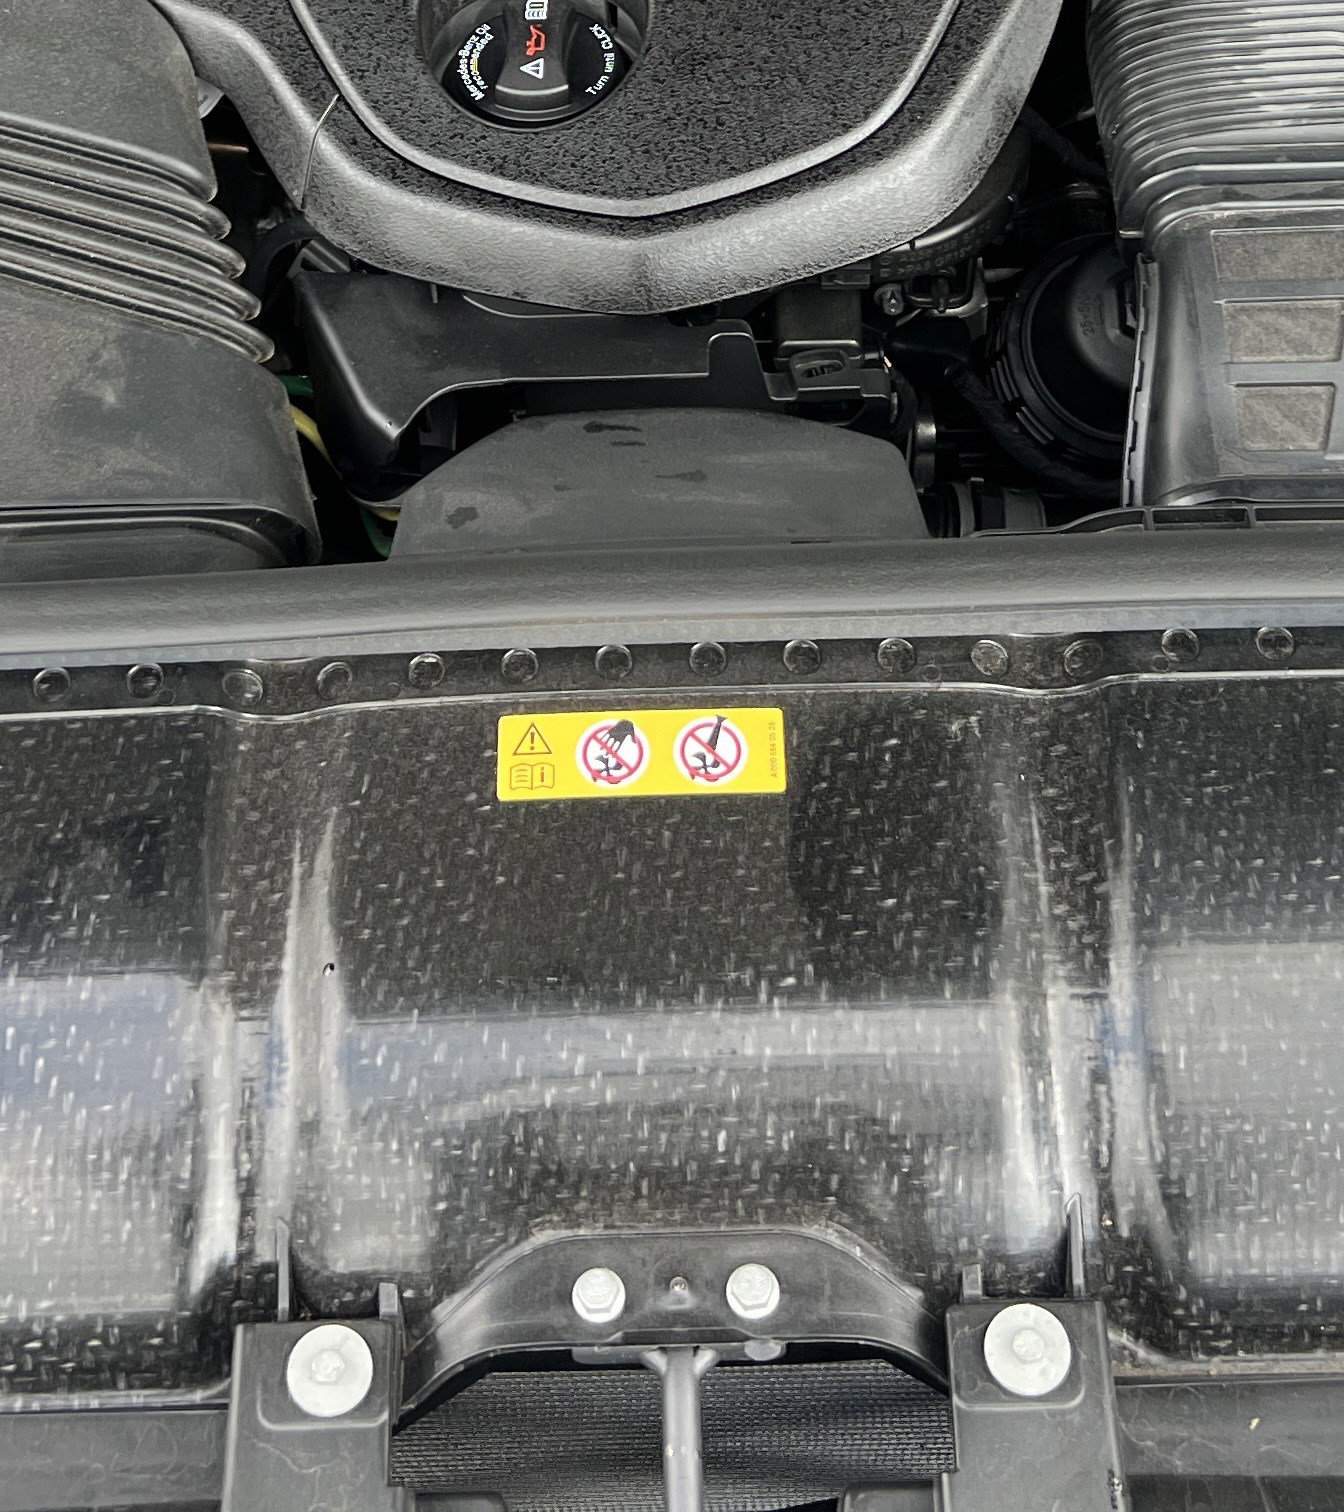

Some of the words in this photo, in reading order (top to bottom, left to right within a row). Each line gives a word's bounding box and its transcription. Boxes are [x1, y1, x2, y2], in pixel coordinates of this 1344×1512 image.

[456, 34, 485, 101] Mercedes-Benz
[469, 32, 494, 90] recommended
[585, 75, 609, 95] Turn
[603, 53, 615, 73] until
